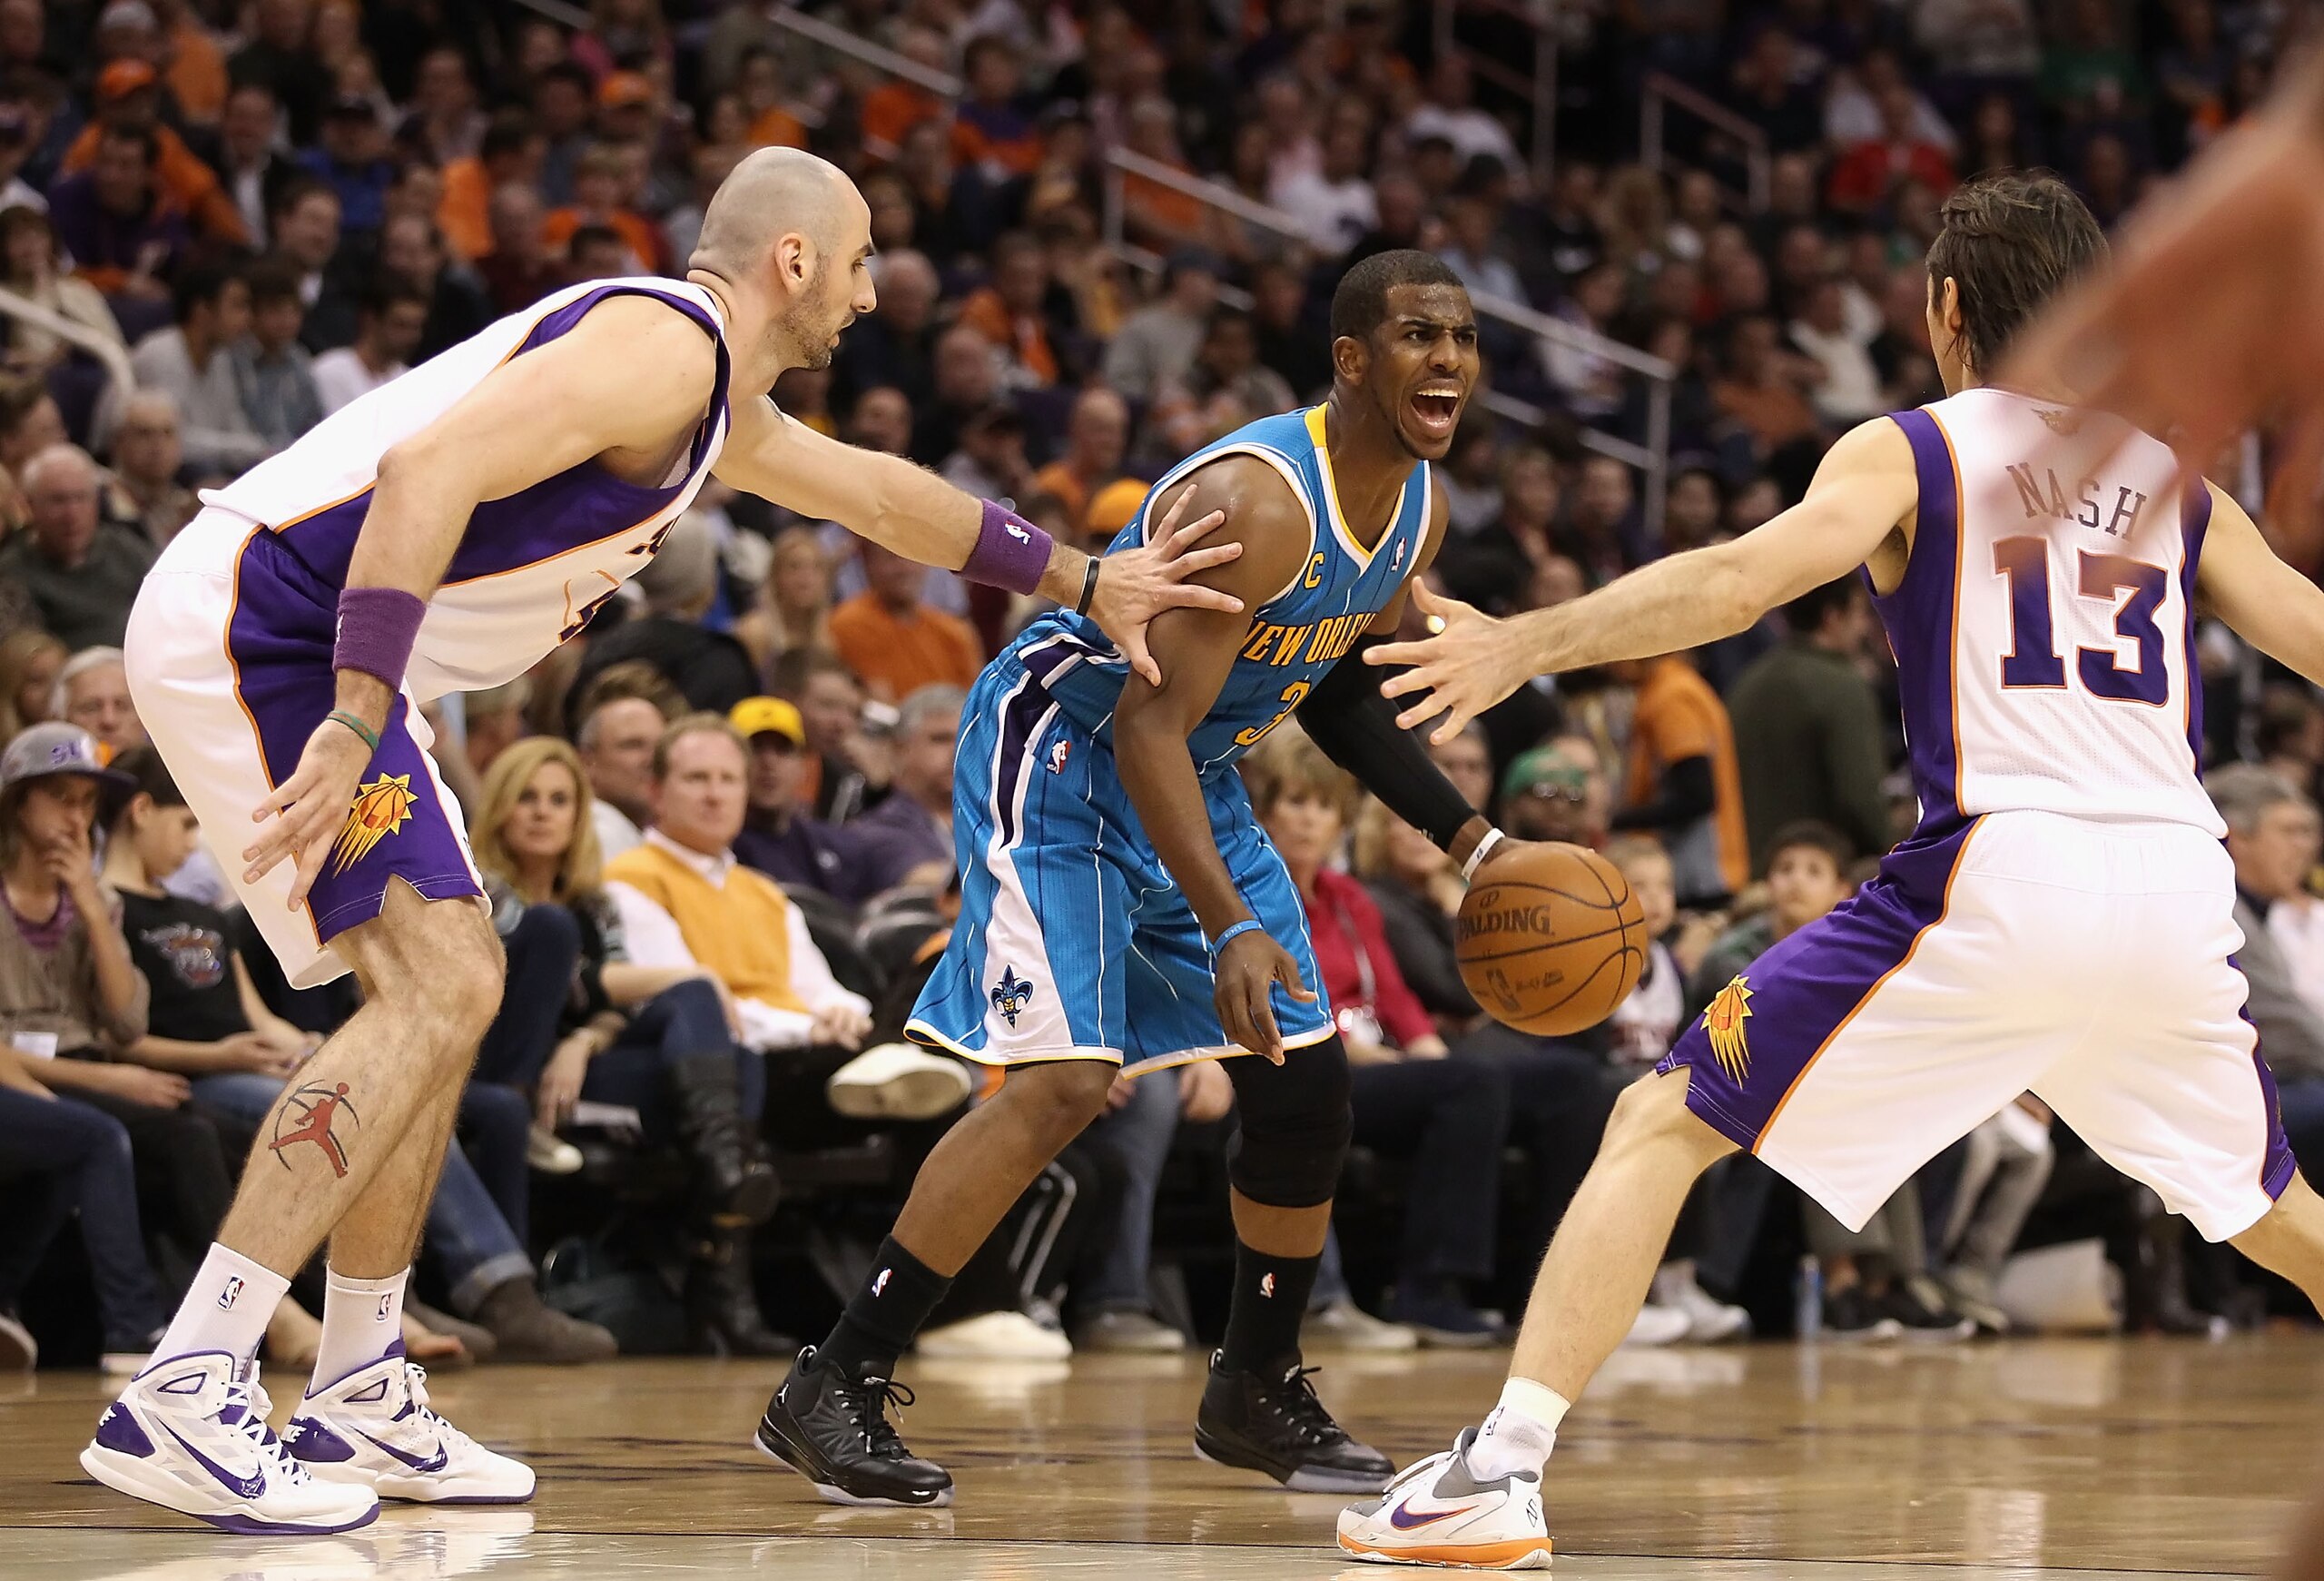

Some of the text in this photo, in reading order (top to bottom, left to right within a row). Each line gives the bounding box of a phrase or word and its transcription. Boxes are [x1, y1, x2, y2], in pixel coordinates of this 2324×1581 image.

[2004, 461, 2148, 539] NASH
[1304, 551, 1325, 589] C
[1992, 534, 2170, 707] 13
[1234, 681, 1311, 746] 3
